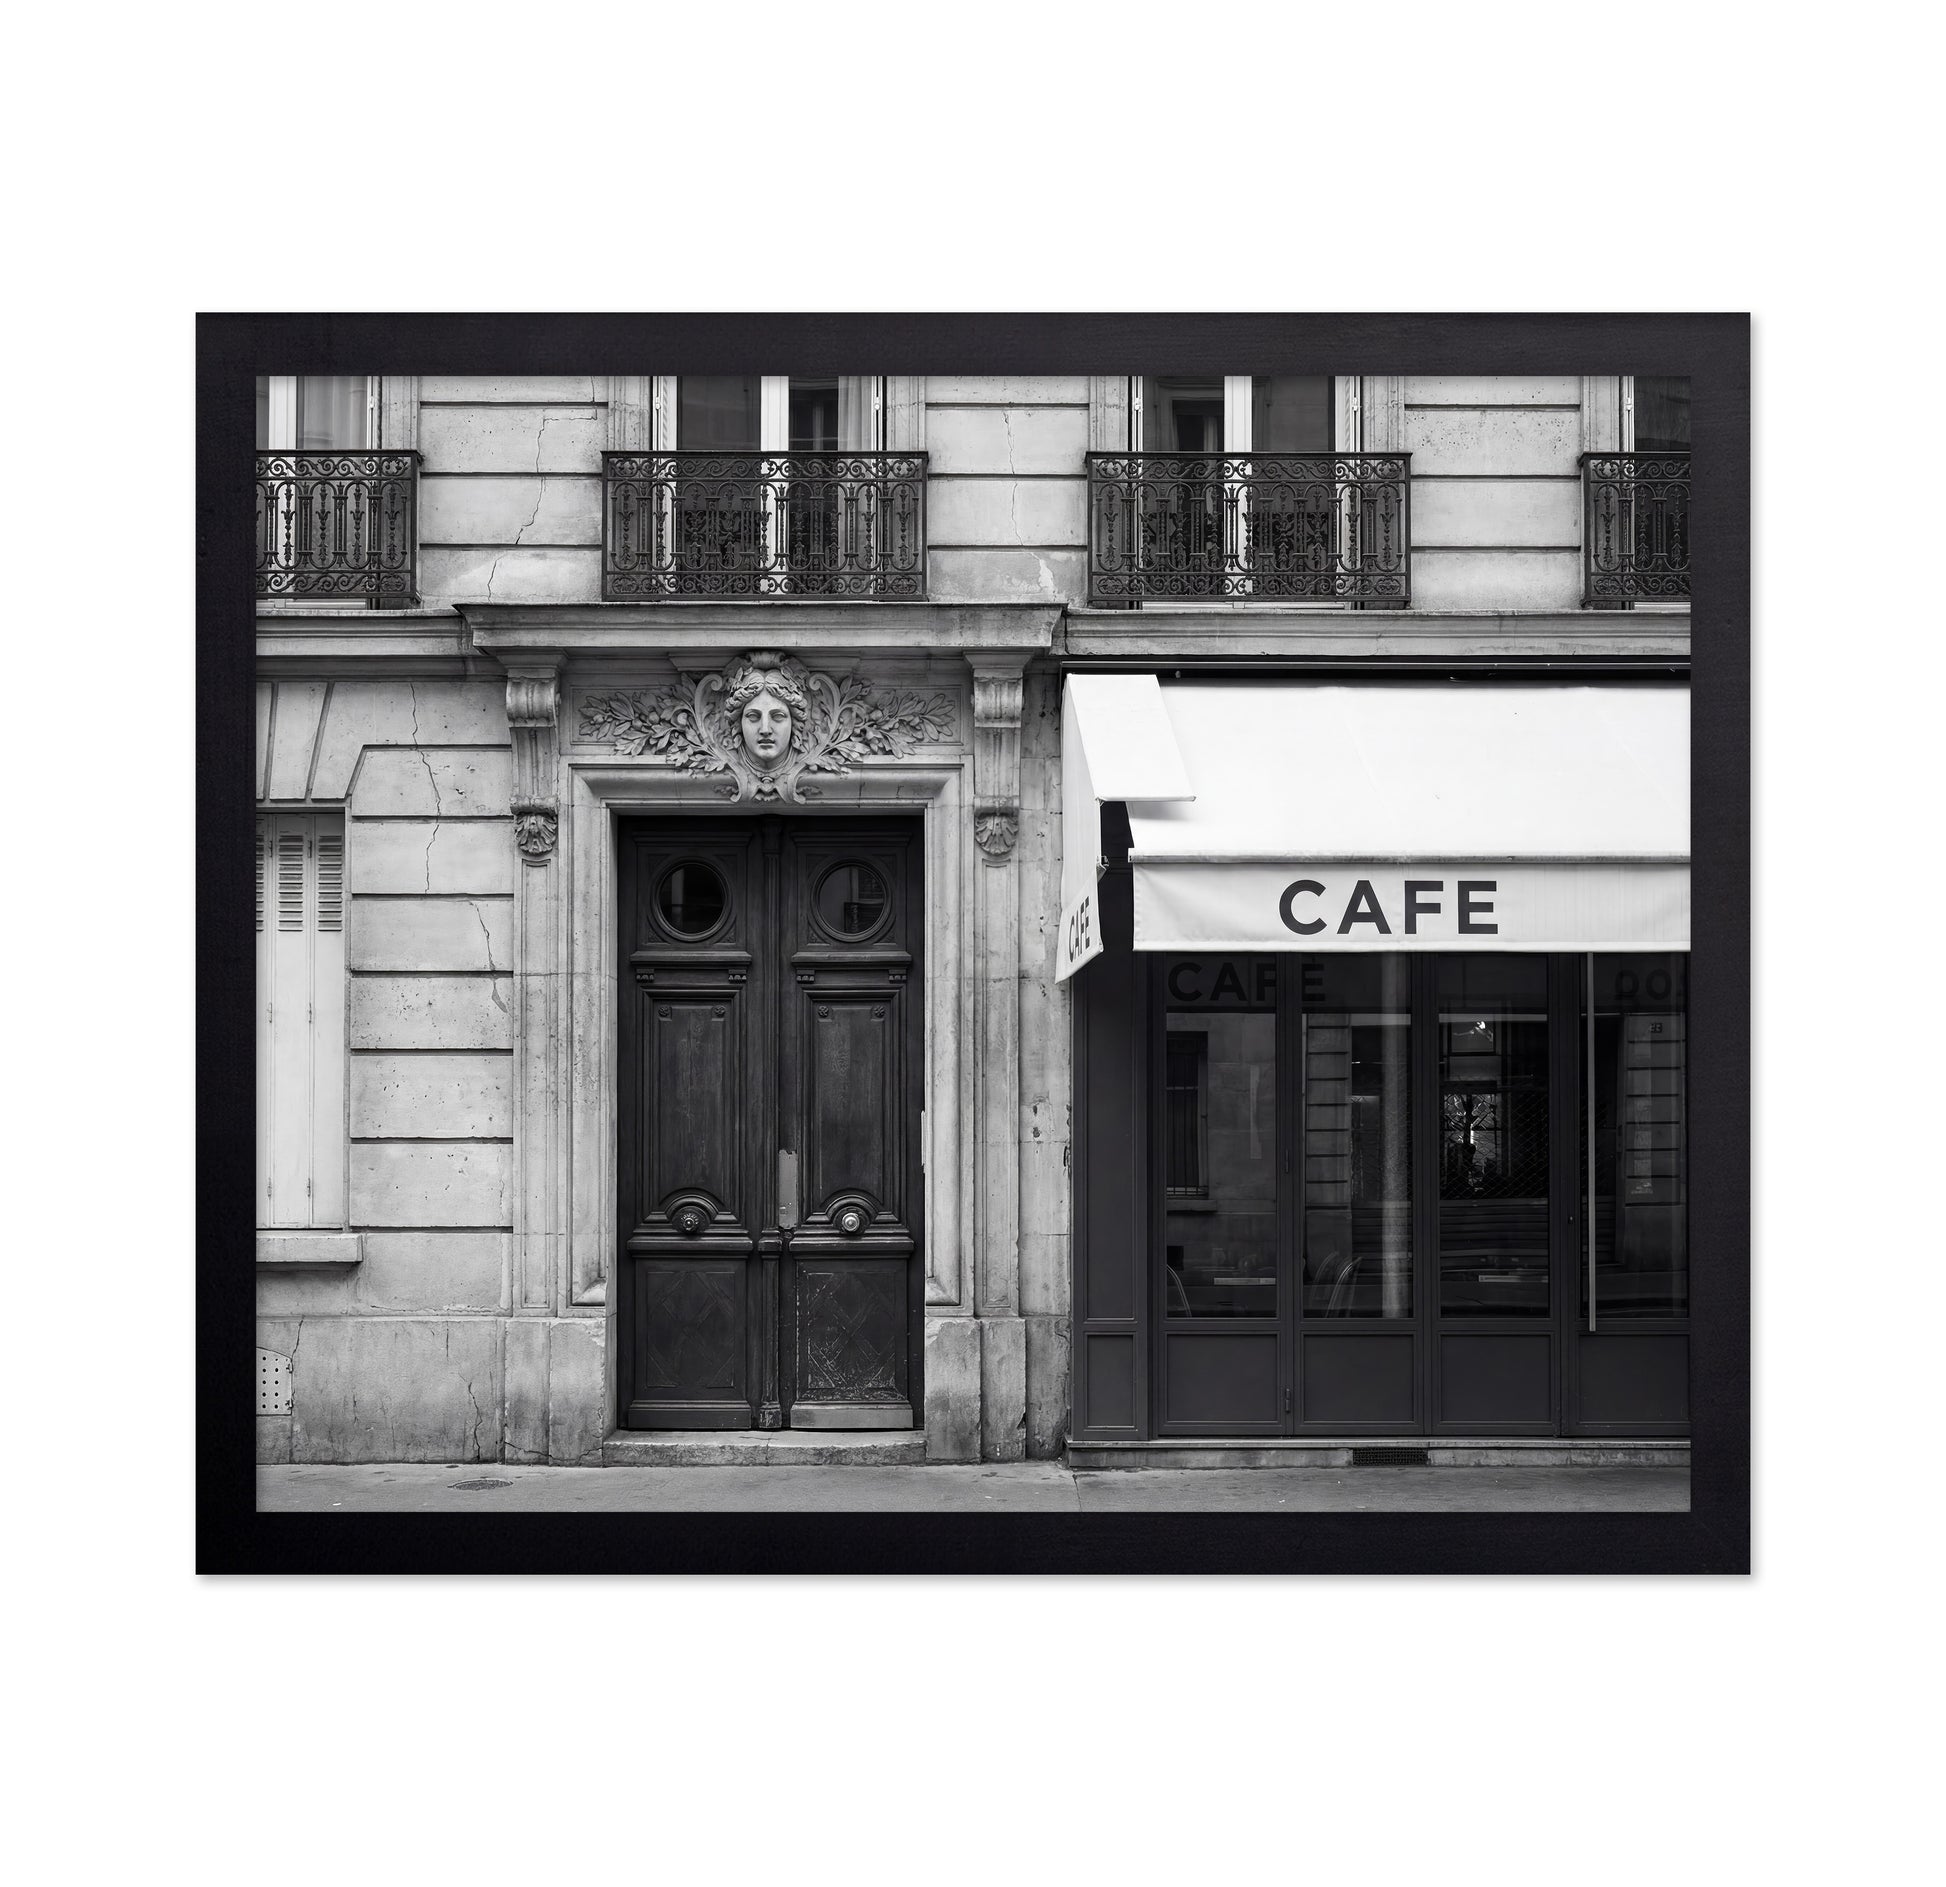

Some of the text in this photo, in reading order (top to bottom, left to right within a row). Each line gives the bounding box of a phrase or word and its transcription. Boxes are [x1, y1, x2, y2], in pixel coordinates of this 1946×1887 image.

[1068, 896, 1091, 963] CAFE
[1278, 879, 1499, 935] CAFE
[1167, 961, 1326, 1002] CAFE
